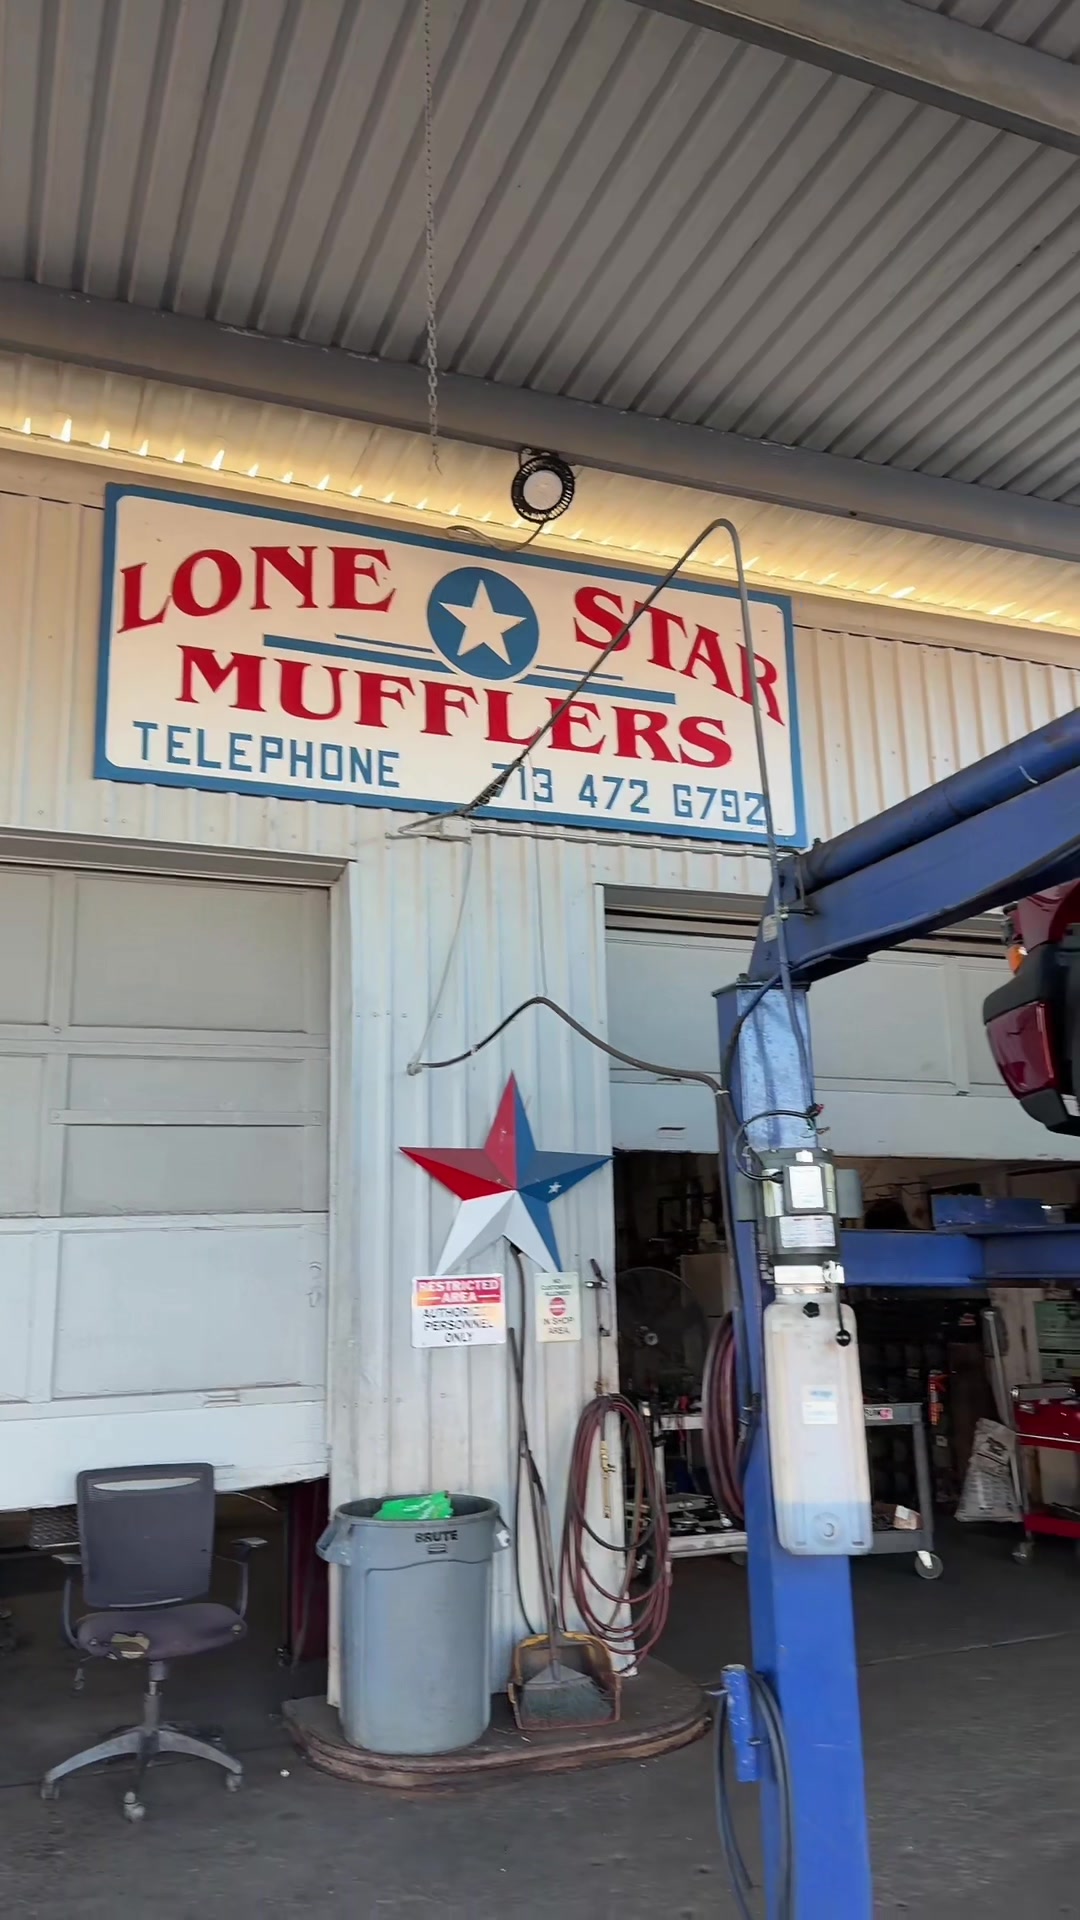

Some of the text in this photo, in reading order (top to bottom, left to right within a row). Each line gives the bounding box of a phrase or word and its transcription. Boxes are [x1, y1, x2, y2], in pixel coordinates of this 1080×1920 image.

[117, 545, 786, 726] LONE STAR
[175, 644, 733, 768] MUFFLERS
[132, 720, 400, 788] TELEPHONE
[578, 774, 650, 815] 472
[418, 1280, 499, 1292] RESTRICTED
[441, 1291, 478, 1303] AREA
[424, 1319, 493, 1331] PERSONNEL
[444, 1332, 472, 1343] ONLY
[415, 1530, 458, 1543] BRUTE
